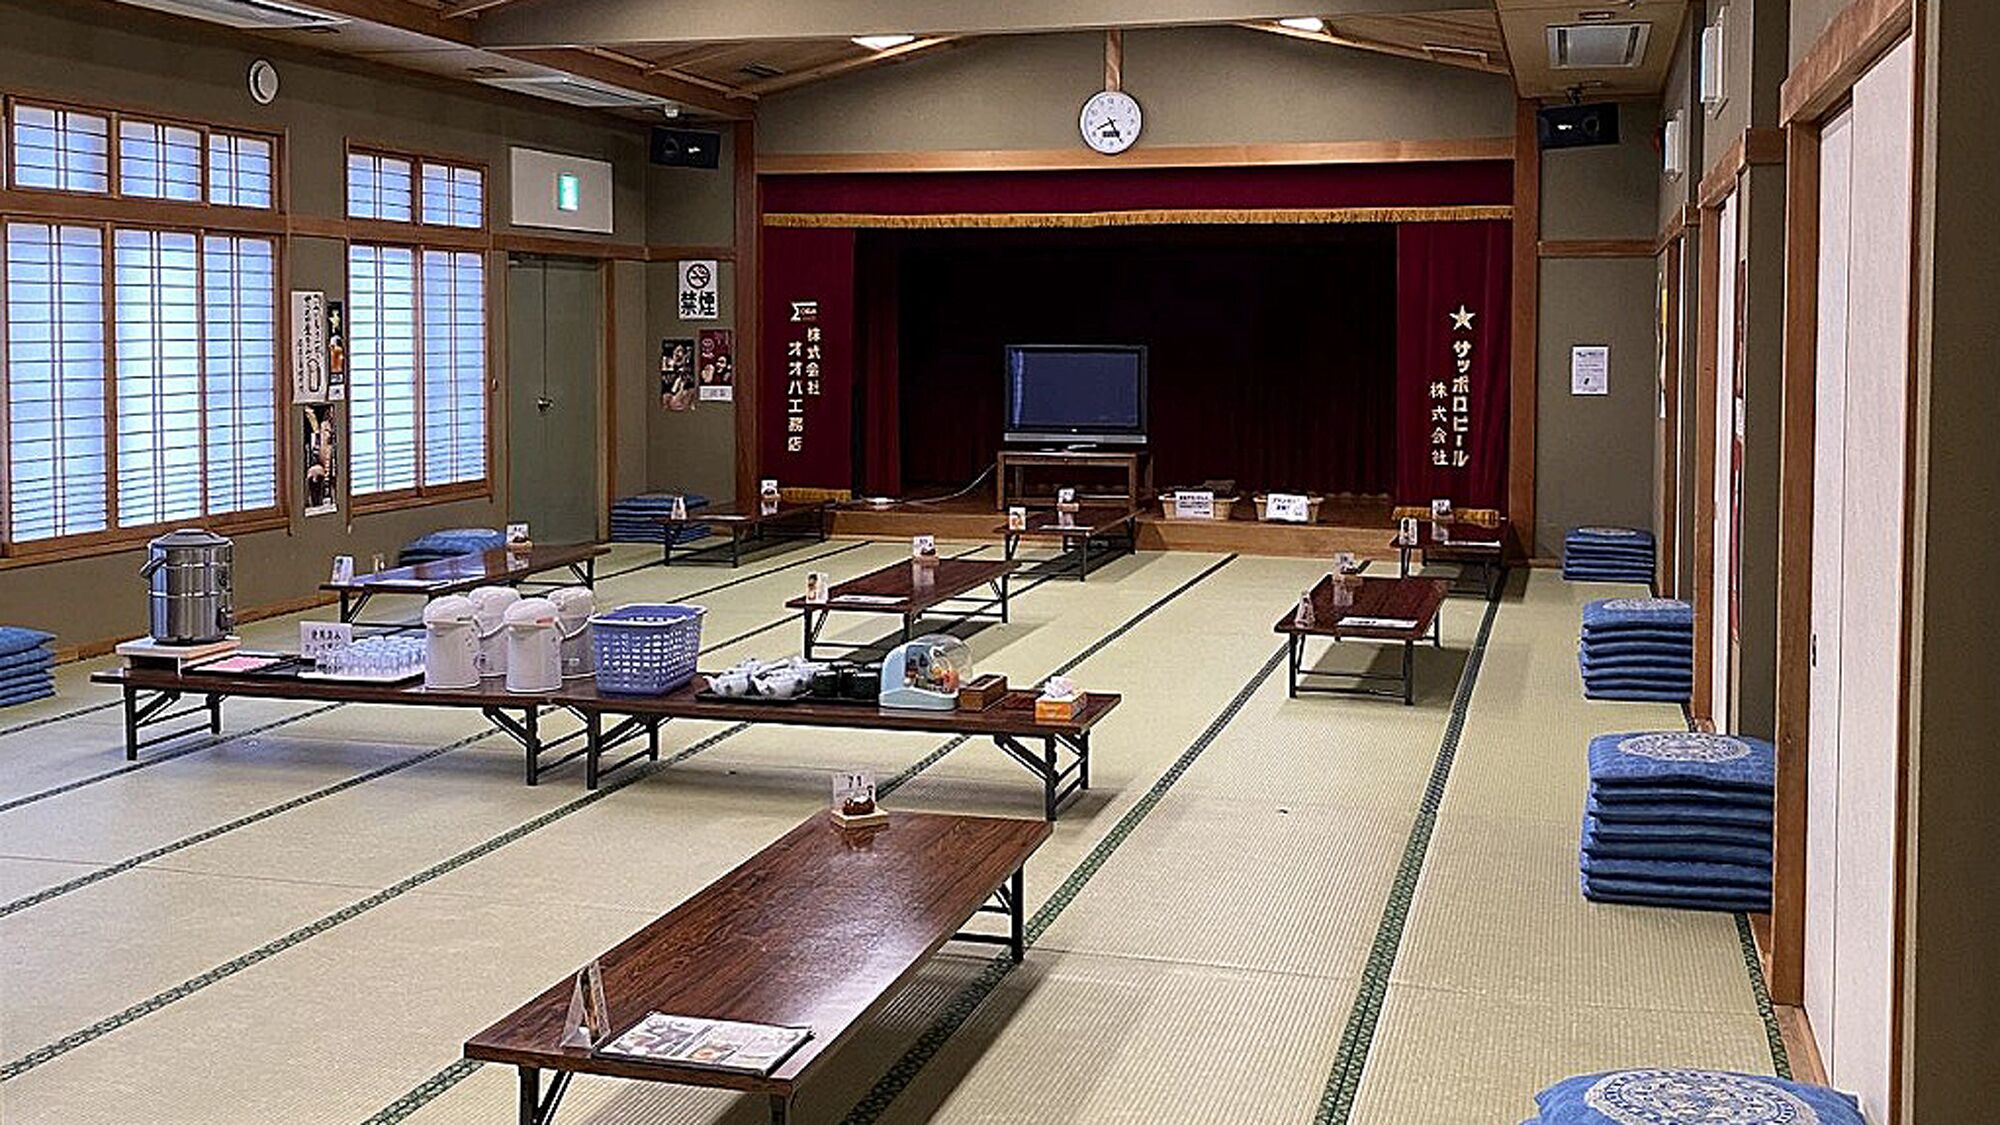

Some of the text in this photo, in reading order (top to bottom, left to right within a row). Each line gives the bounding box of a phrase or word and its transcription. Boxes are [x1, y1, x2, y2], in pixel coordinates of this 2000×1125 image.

[680, 290, 715, 316] 禁煙
[806, 327, 821, 395] 株式会社
[1429, 381, 1449, 466] 株式会社
[1452, 340, 1472, 467] サッポロビール
